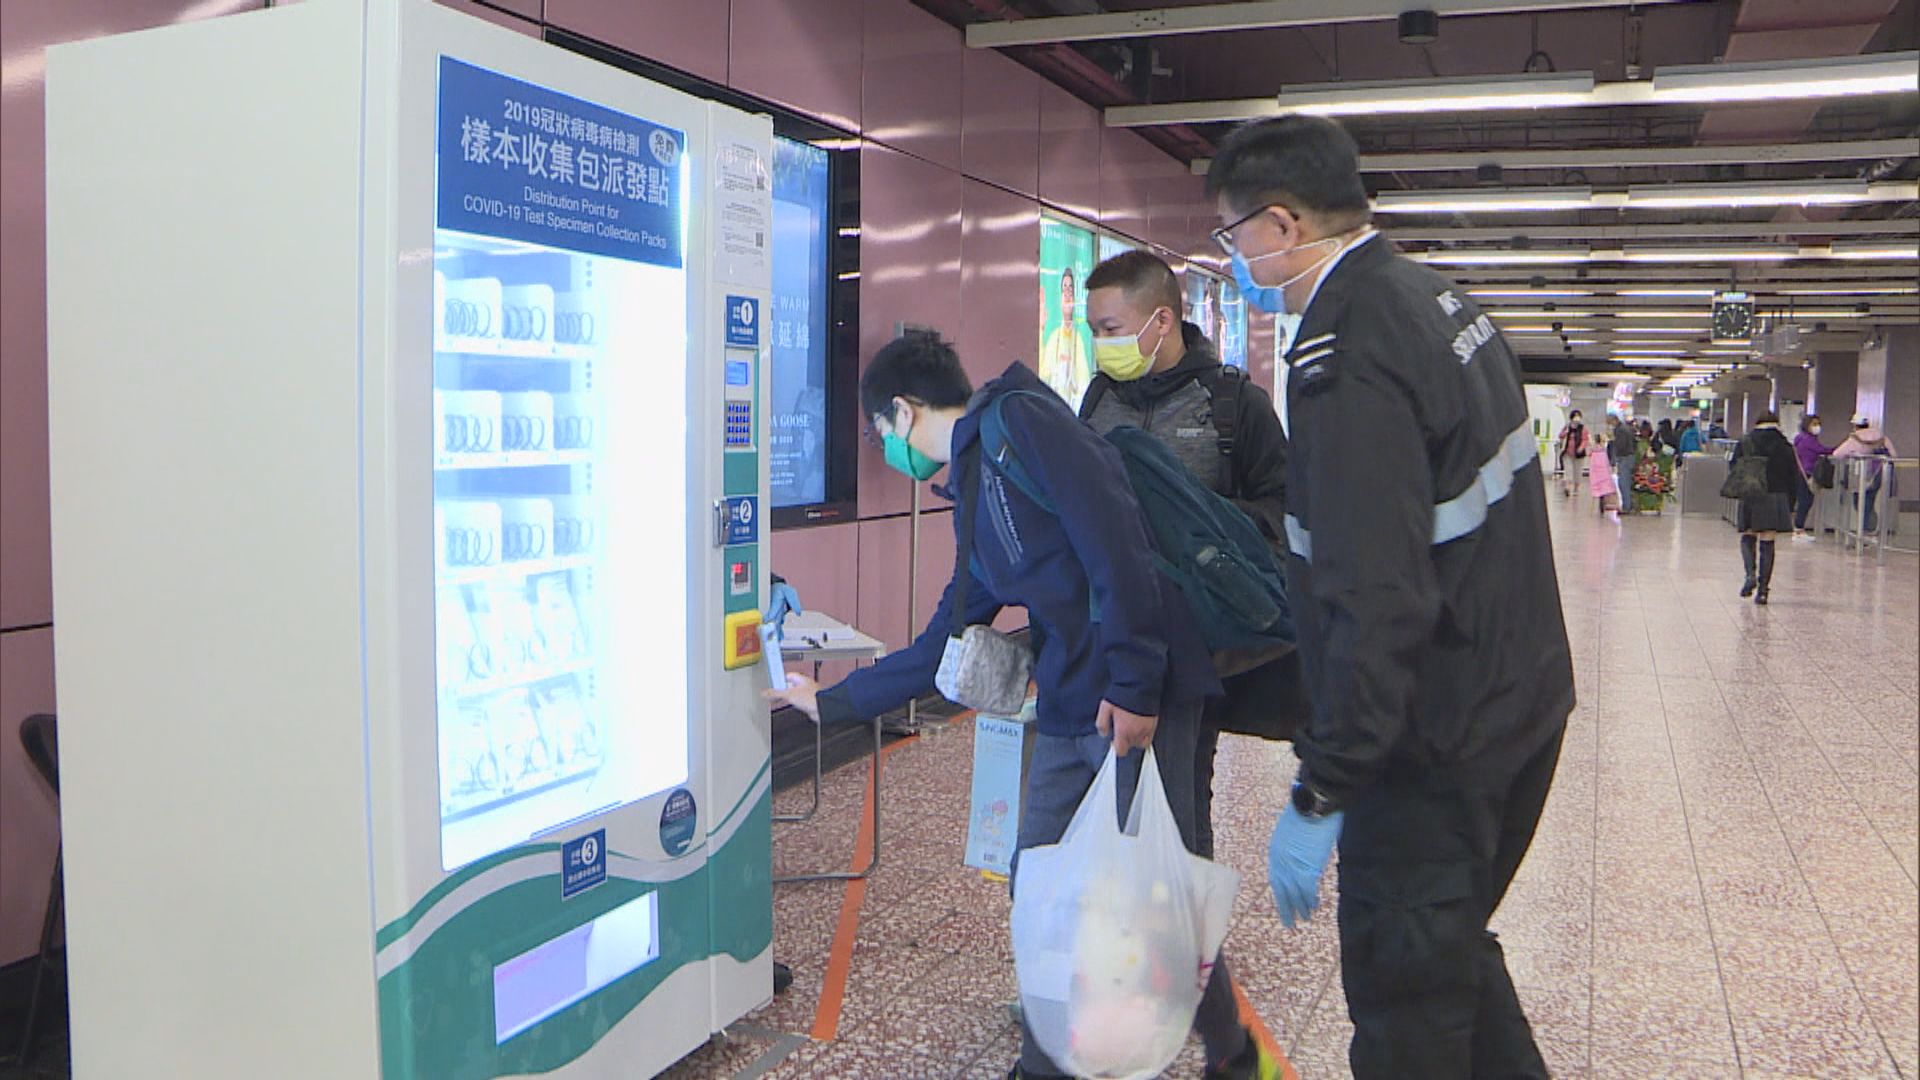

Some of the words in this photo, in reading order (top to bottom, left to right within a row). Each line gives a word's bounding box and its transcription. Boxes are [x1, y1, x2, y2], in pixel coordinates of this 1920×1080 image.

[503, 98, 640, 158] 2019冠狀病毒病檢測
[460, 114, 669, 208] 樣本收集包派發點
[463, 193, 521, 221] COVID-19
[522, 205, 546, 226] Test
[546, 211, 596, 236] Specimen
[596, 222, 641, 244] Collection
[641, 229, 668, 250] Packs
[523, 185, 580, 212] Distribution
[581, 198, 606, 217] Point
[607, 204, 620, 220] for
